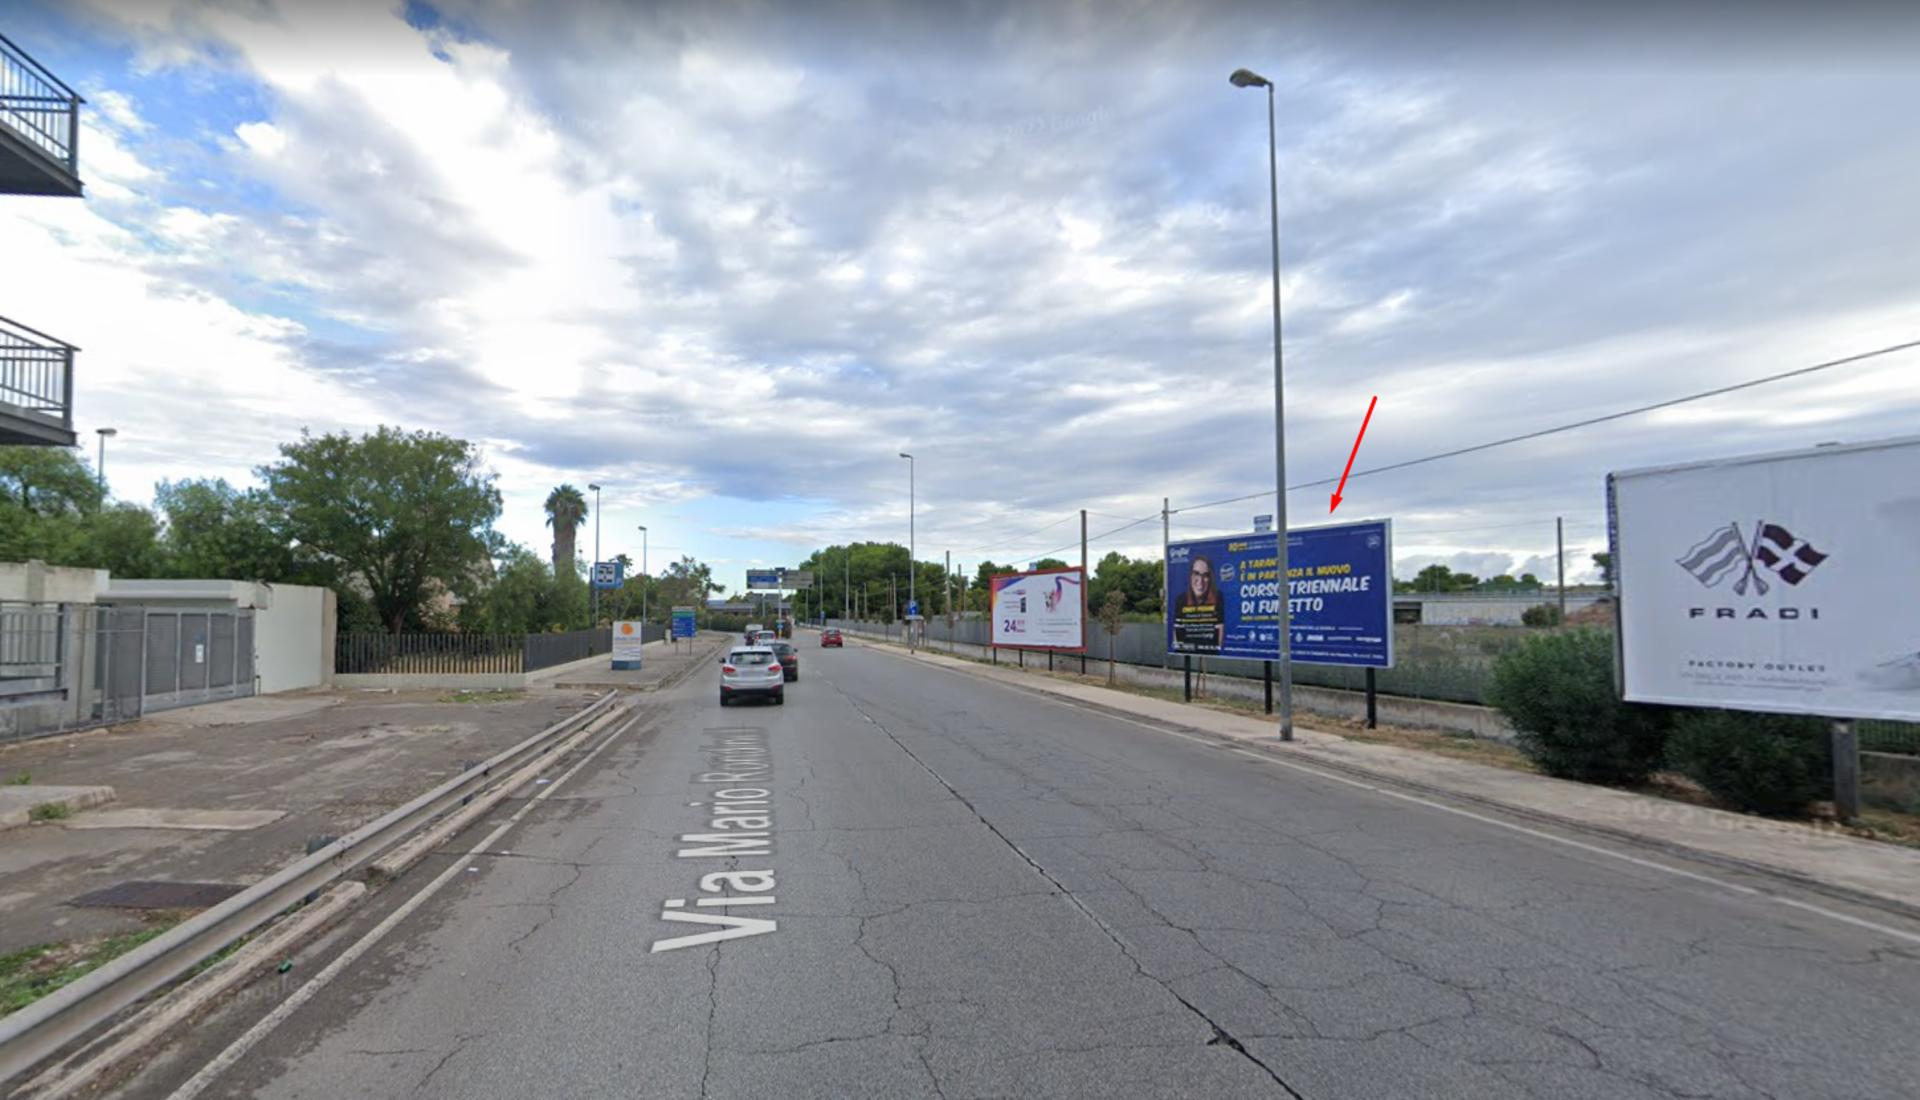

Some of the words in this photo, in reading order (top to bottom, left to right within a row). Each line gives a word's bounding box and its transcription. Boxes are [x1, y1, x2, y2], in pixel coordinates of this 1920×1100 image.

[1249, 557, 1280, 569] TARAN
[1258, 567, 1303, 580] PARNZA
[1316, 563, 1352, 576] NUOVO
[1288, 576, 1371, 596] TRIENNALE
[1241, 600, 1255, 615] DI
[1688, 607, 1820, 620] FRADI
[1003, 619, 1017, 633] 24
[1687, 660, 1755, 669] FACTORY
[1763, 662, 1826, 672] OUTLET
